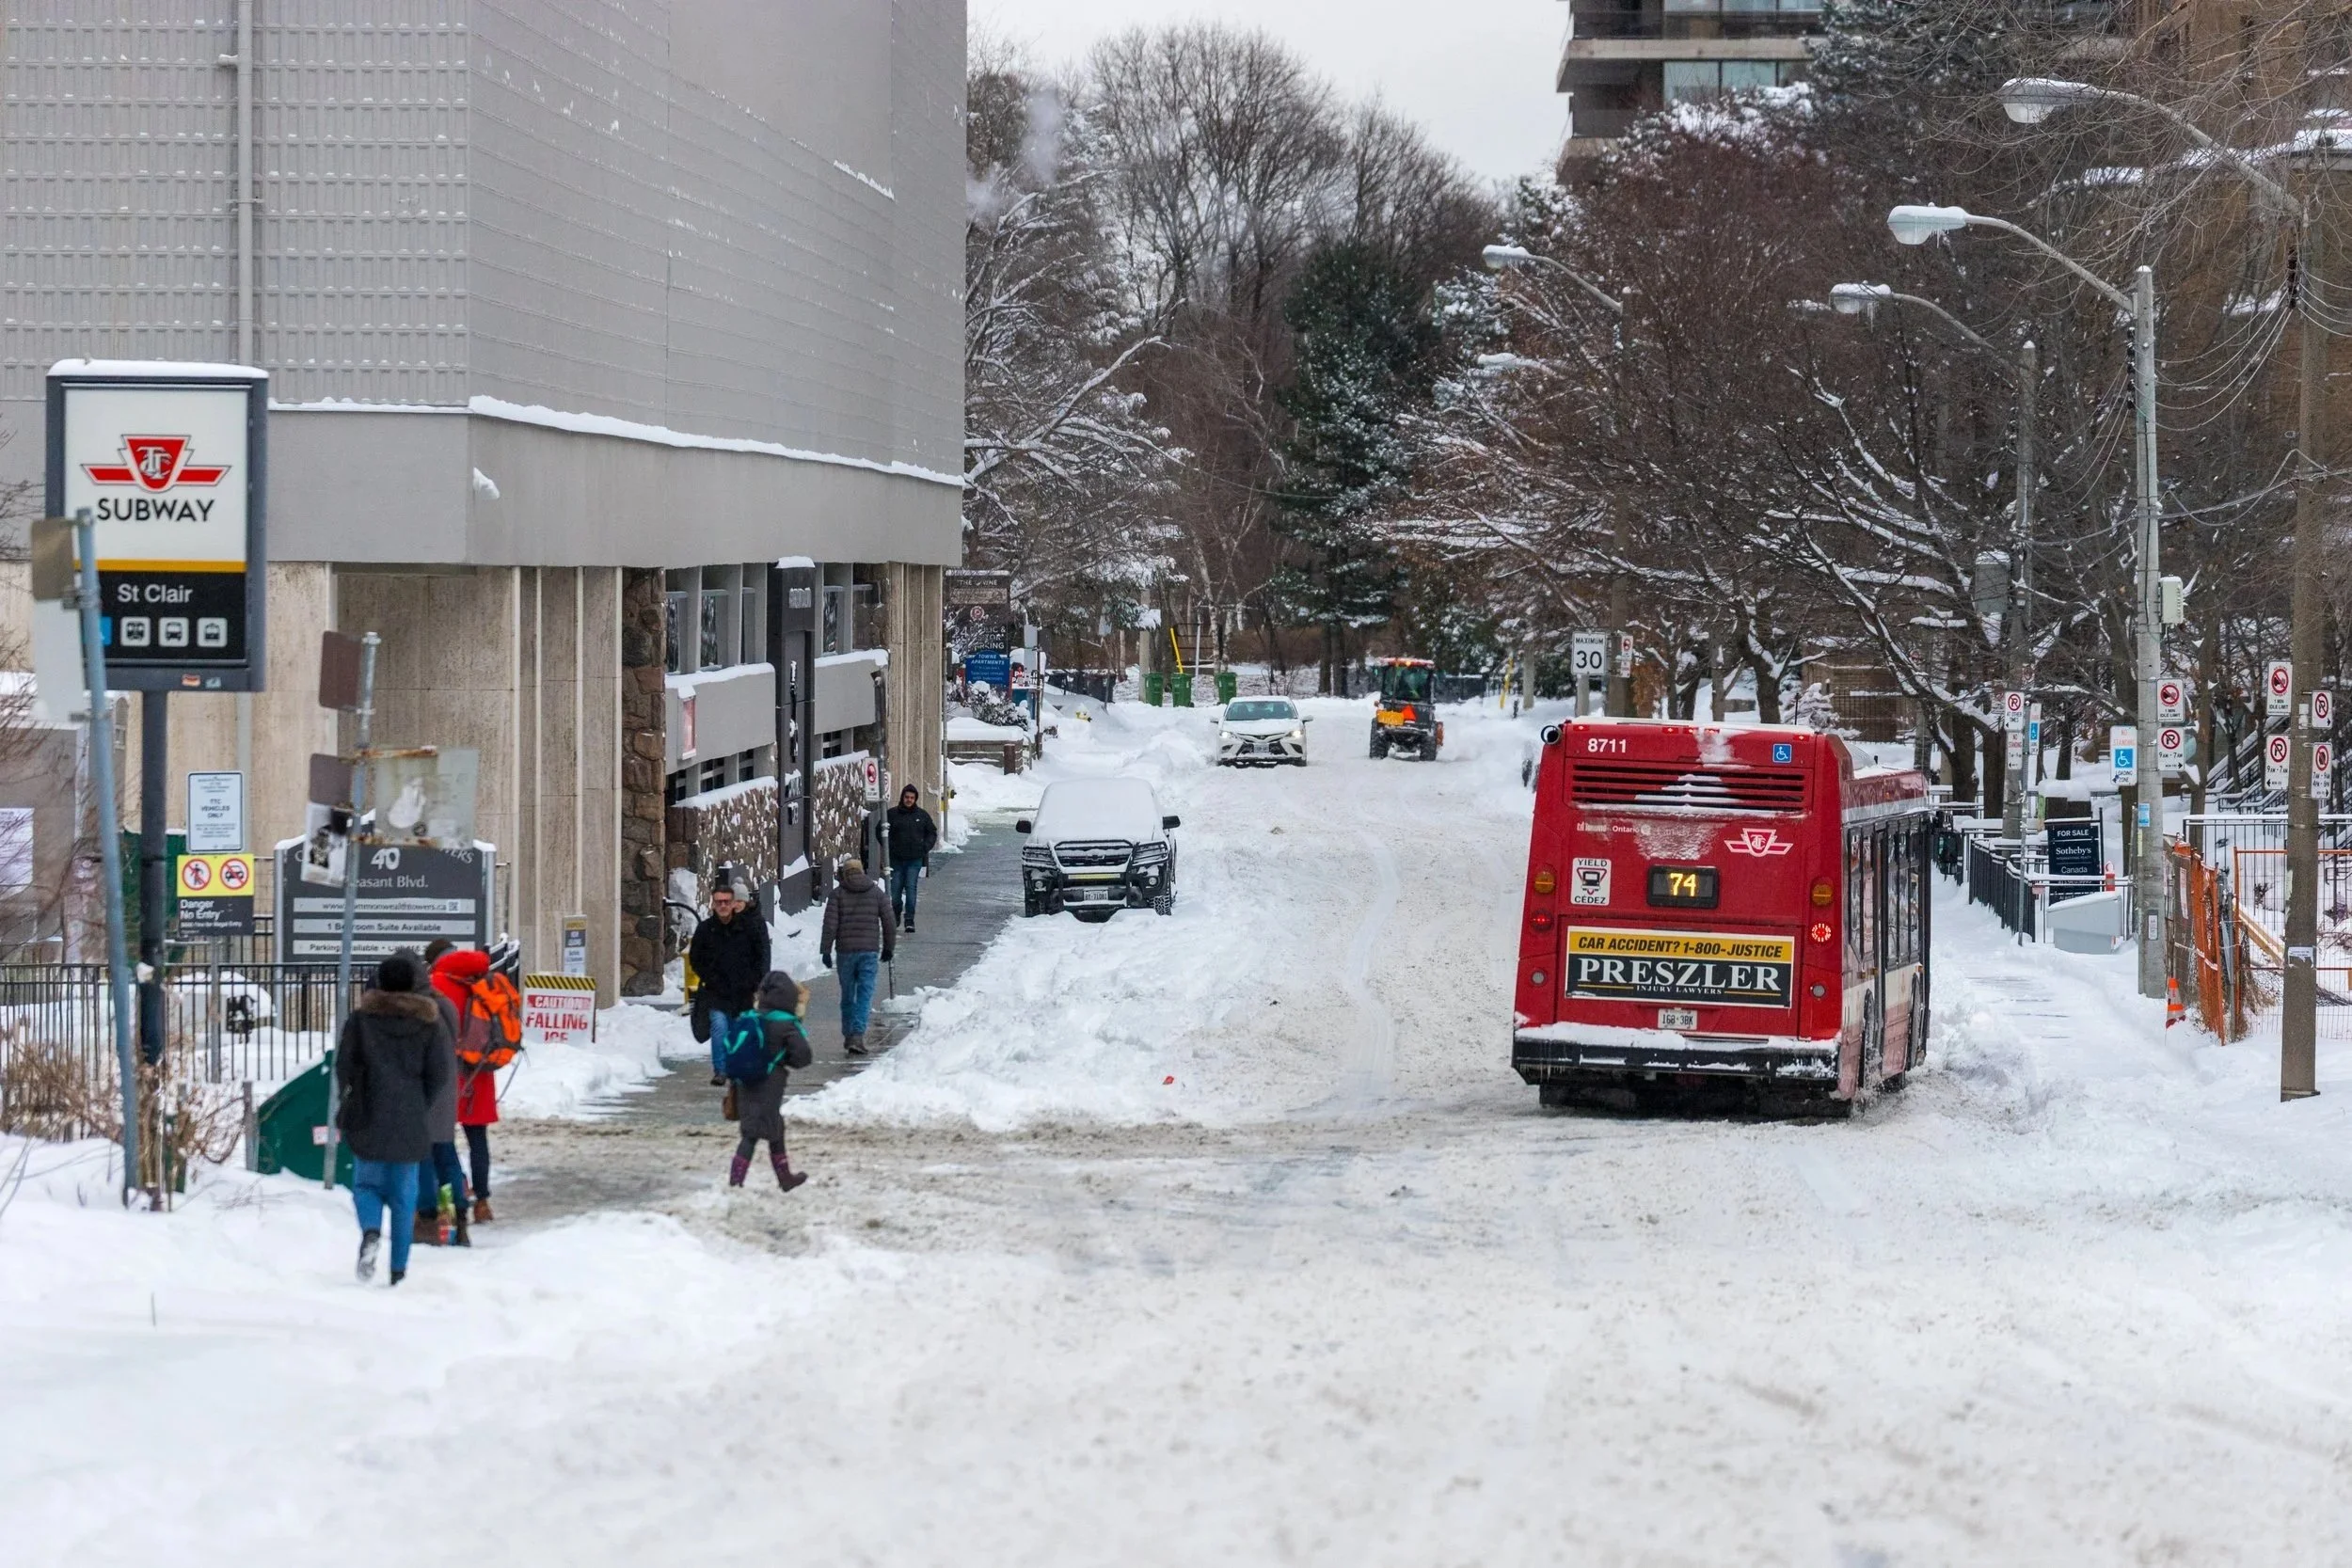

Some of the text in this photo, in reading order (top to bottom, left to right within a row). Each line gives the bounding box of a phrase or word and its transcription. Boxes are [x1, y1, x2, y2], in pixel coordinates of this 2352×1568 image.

[97, 498, 215, 522] SUBWAY
[118, 583, 194, 603] St Clair
[1576, 651, 1602, 669] 30
[1587, 737, 1628, 753] 8711
[1612, 825, 1640, 833] Ontario
[2056, 847, 2091, 855] Sotheby's
[371, 847, 400, 870] 40
[1578, 859, 1607, 867] YIELD
[397, 876, 429, 888] Blvd.
[1670, 873, 1697, 896] 74
[180, 899, 215, 911] Danger
[323, 901, 447, 911] www.mmonwealthtowers.ca
[180, 911, 221, 920] No Entry
[335, 923, 375, 932] Beroom
[377, 924, 398, 932] Suite
[402, 924, 441, 932] Available
[310, 943, 340, 953] Parking
[1579, 937, 1783, 958] CAR ACCIDENT? 1-800-JUSTICE
[1577, 958, 1782, 991] PRESZLER
[1637, 985, 1723, 995] INJURY LAWYERS
[535, 996, 586, 1008] CAUTION
[526, 1012, 588, 1030] FALLING
[545, 1031, 569, 1042] ICE
